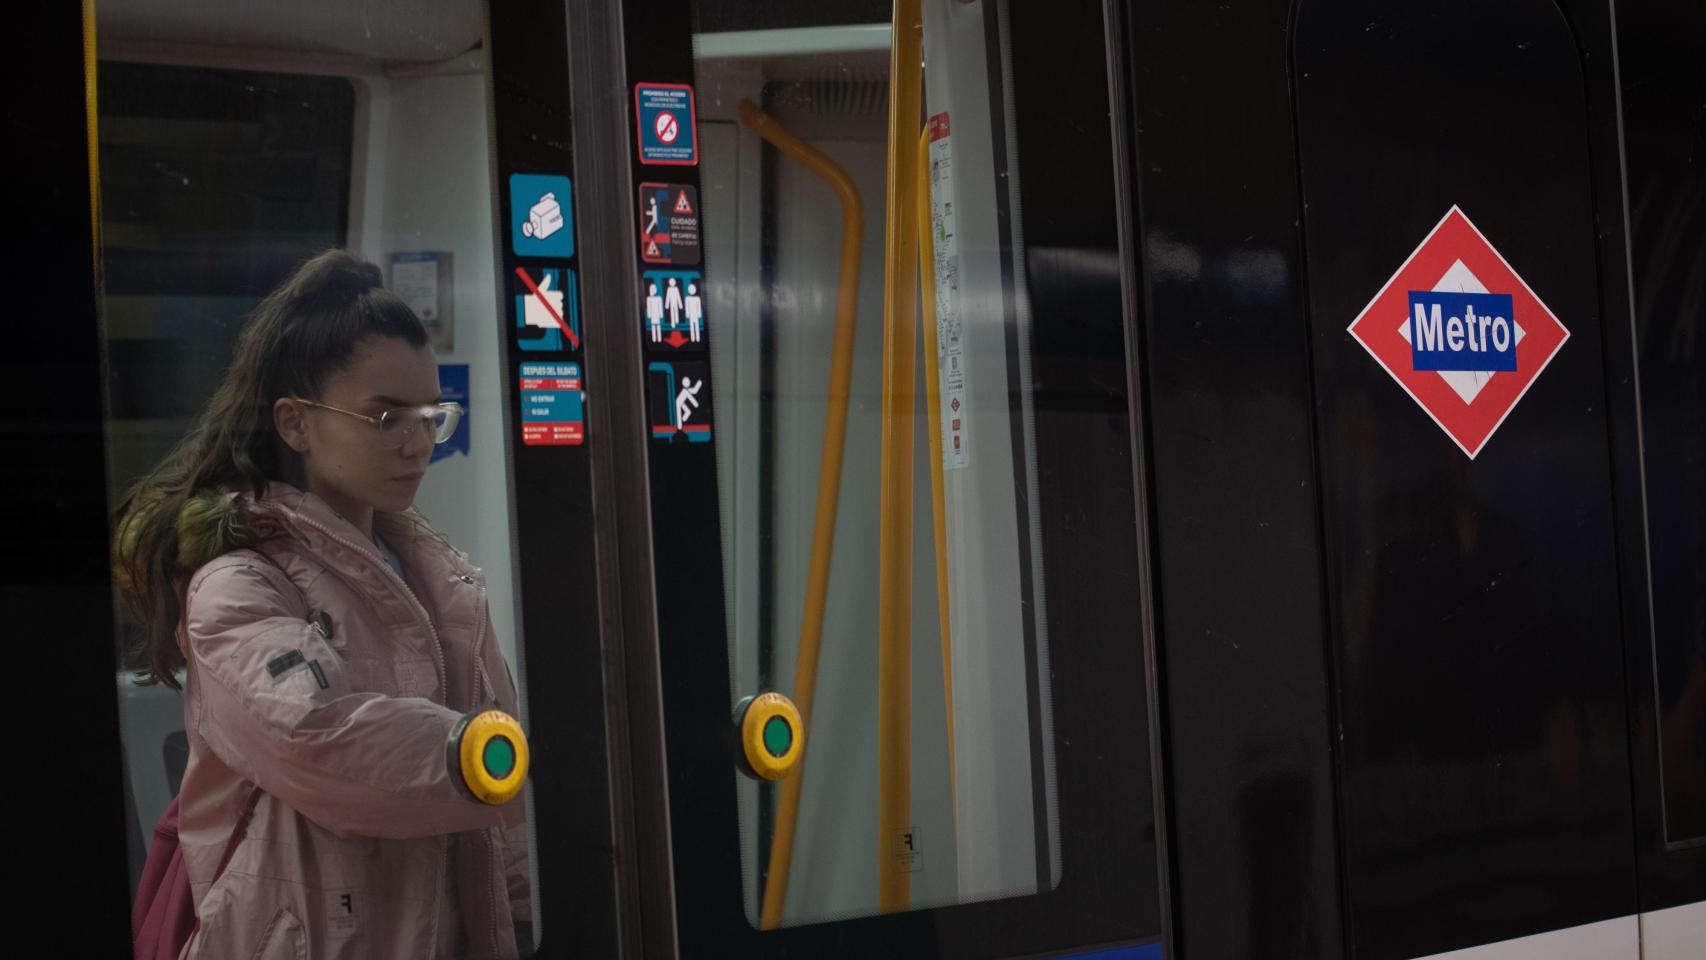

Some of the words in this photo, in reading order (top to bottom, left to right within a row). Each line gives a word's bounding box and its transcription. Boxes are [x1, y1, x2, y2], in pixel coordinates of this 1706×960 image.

[671, 217, 697, 226] CUIDADO
[1414, 303, 1510, 352] Metro
[546, 366, 557, 376] DEL
